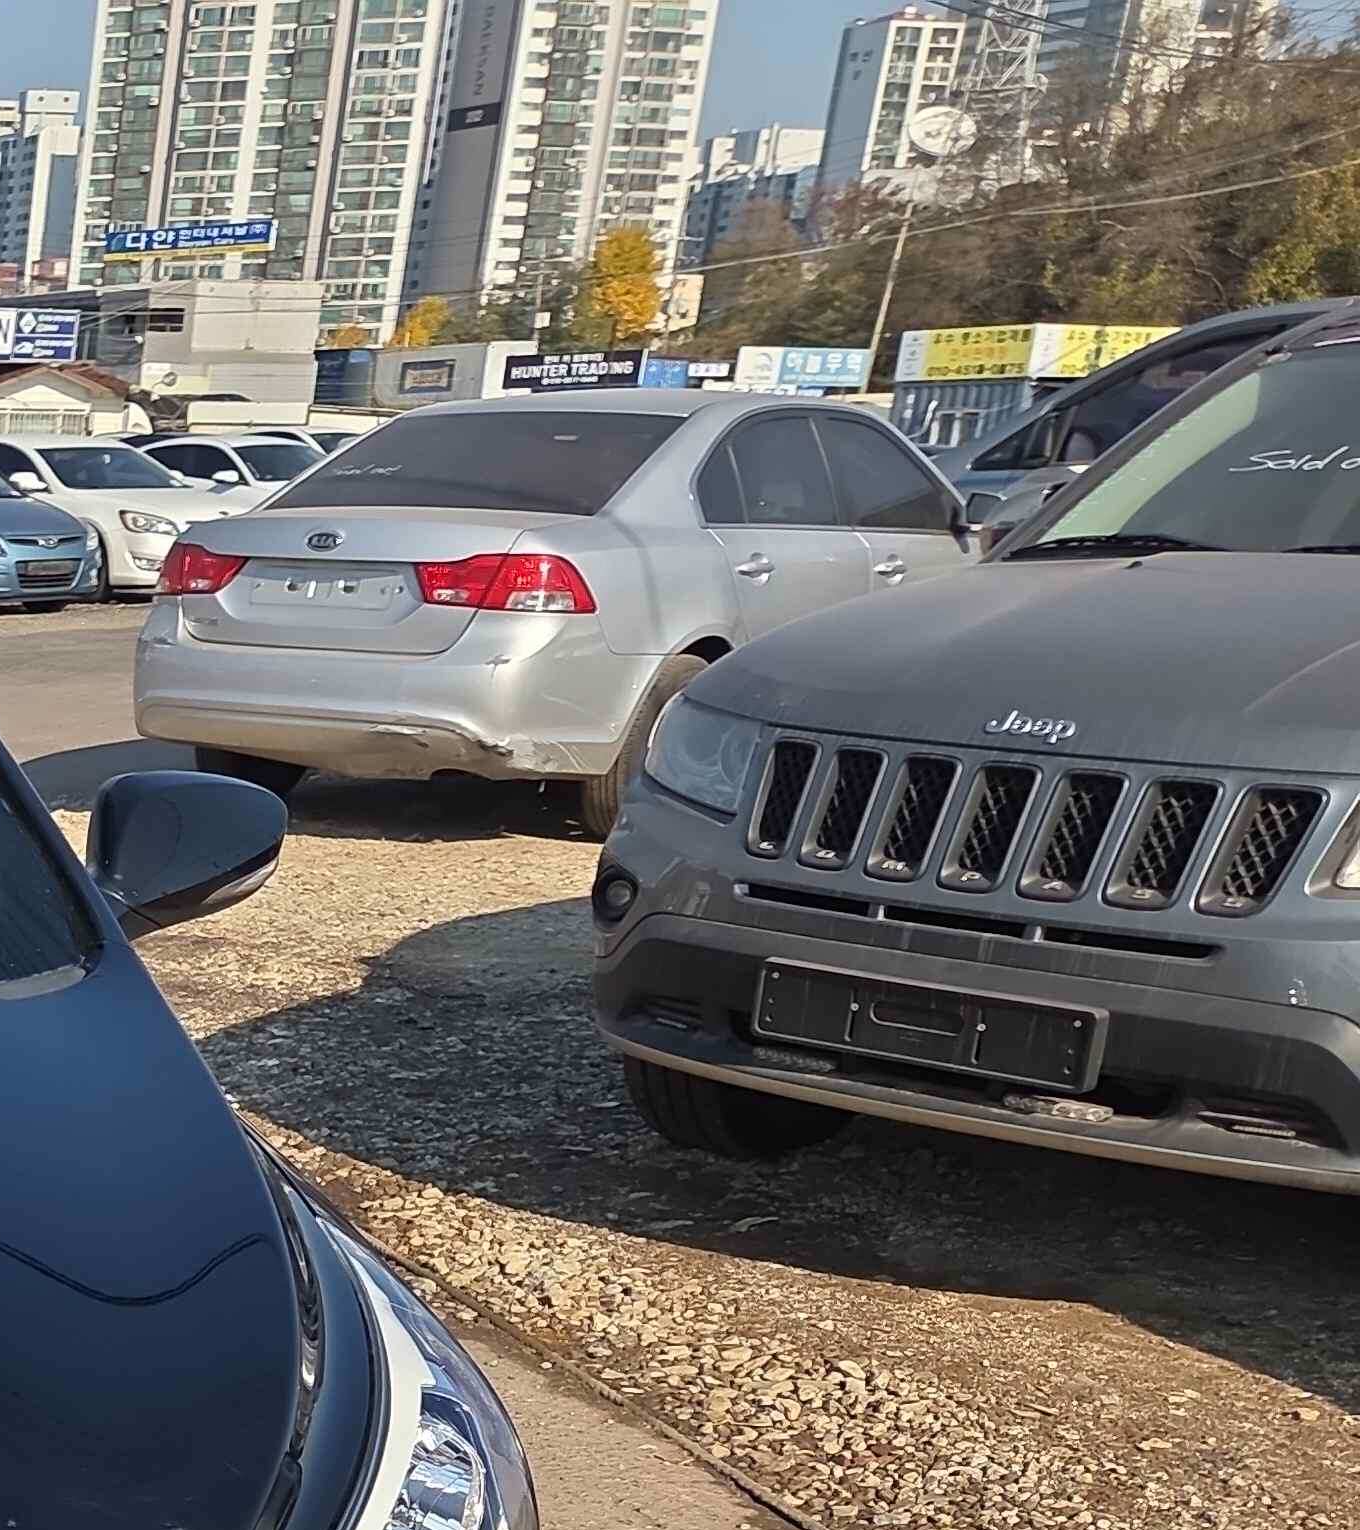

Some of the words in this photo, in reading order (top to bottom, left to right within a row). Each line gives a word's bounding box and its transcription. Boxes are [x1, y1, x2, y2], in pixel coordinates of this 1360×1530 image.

[510, 363, 569, 379] HUNTER
[570, 361, 635, 376] TRADING
[1228, 445, 1350, 472] Sold
[984, 709, 1077, 744] Jeep
